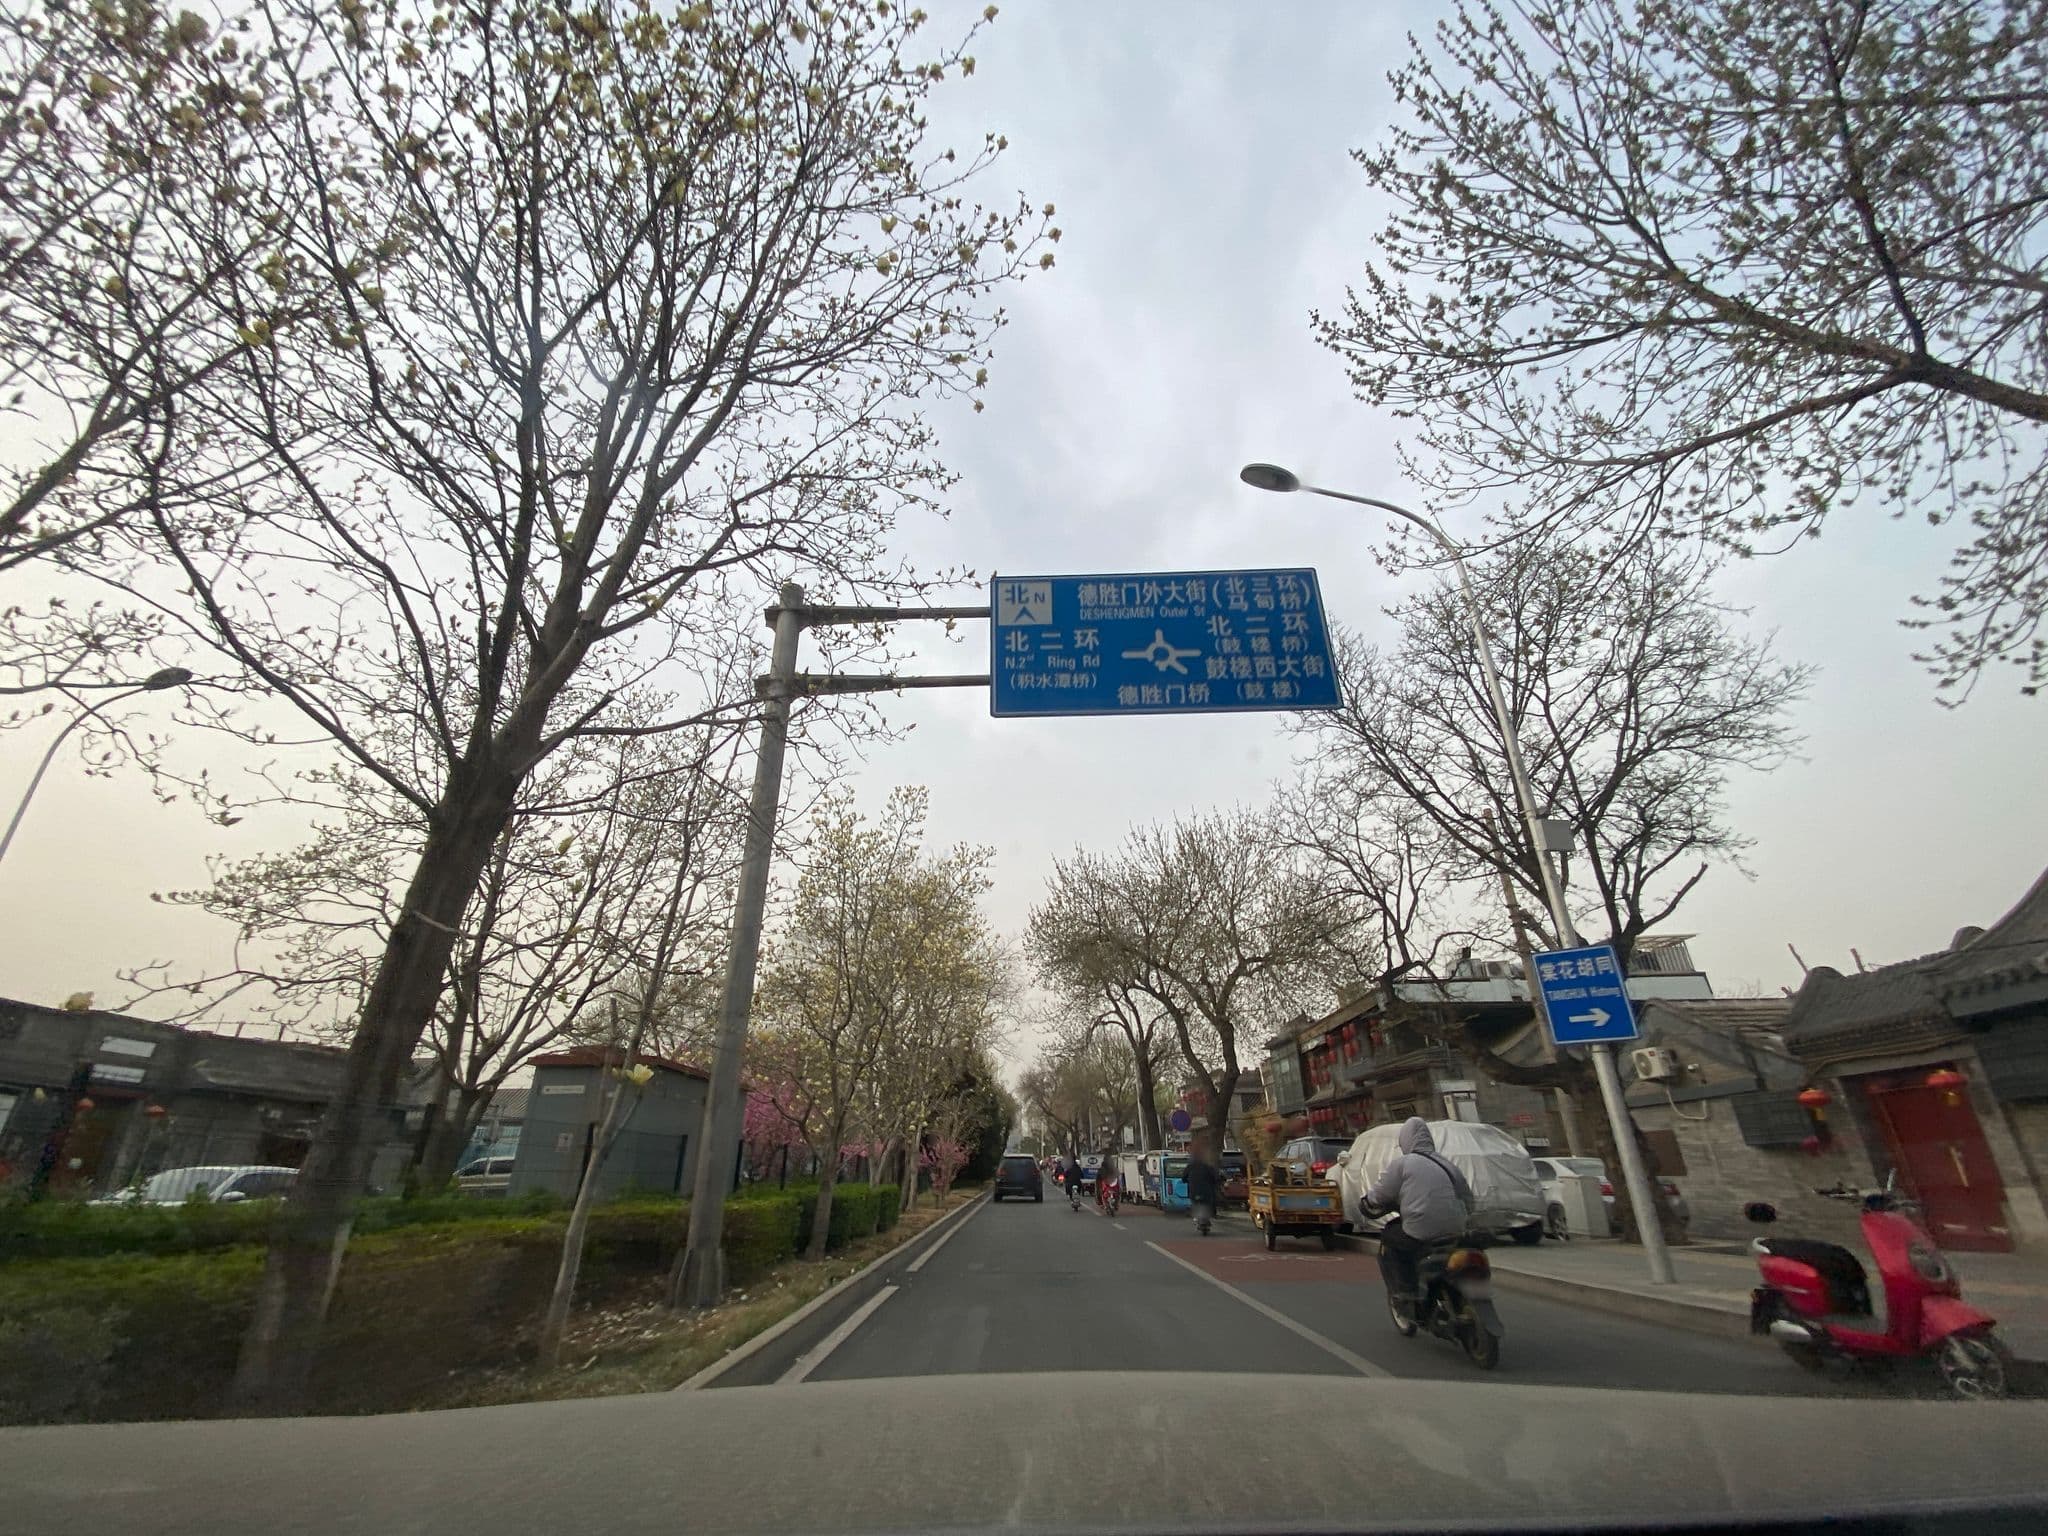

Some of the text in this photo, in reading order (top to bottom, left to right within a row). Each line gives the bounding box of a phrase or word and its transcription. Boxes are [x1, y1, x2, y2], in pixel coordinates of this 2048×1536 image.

[1005, 584, 1028, 605] 北
[1034, 592, 1045, 603] N
[1077, 580, 1206, 606] 德胜门外大街
[1080, 605, 1206, 620] DESHENGMEN Outer St
[1206, 613, 1308, 635] 北二环
[1005, 628, 1100, 652] 北二环
[1047, 655, 1076, 670] Ring
[1083, 656, 1100, 668] Rd
[1205, 655, 1324, 679] 鼓楼西大街
[1117, 683, 1210, 705] 德胜门桥
